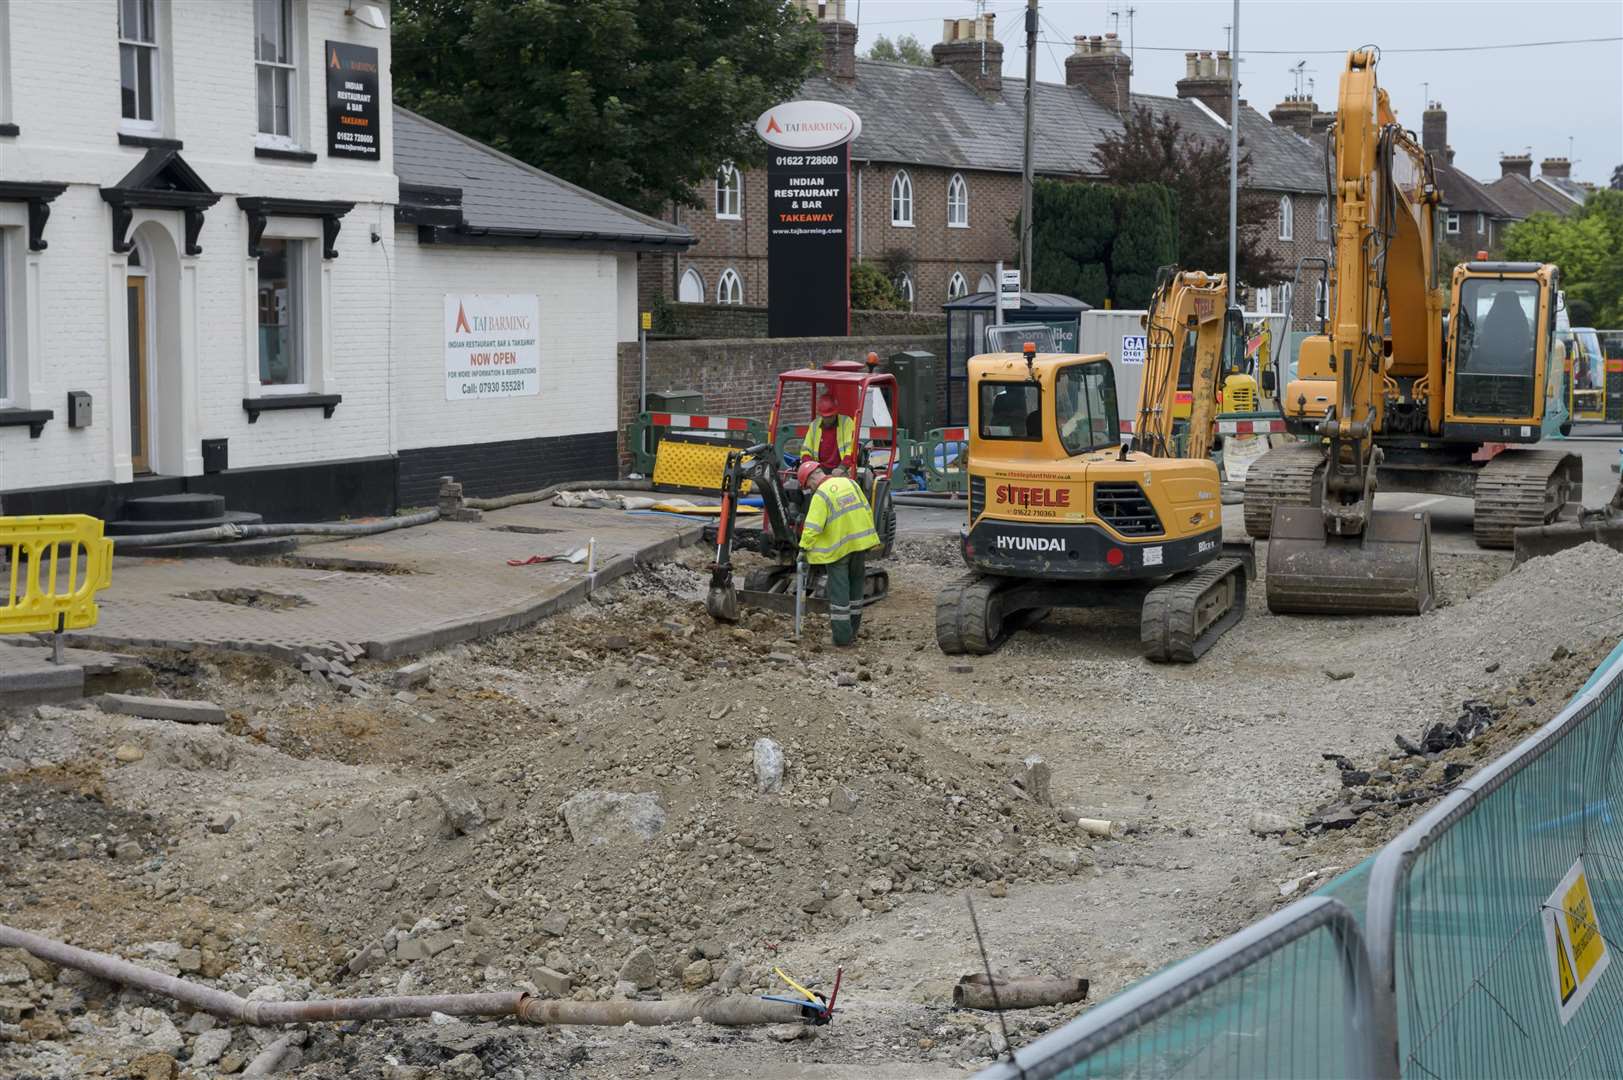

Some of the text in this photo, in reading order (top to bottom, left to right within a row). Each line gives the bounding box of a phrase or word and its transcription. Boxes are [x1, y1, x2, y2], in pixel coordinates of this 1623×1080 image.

[345, 81, 364, 91] INDIAN
[337, 91, 371, 103] RESTAURANT
[346, 103, 363, 112] & BAR
[341, 115, 369, 127] TAKEAWAY
[785, 122, 847, 132] TAJ BARMING
[337, 132, 353, 141] 01622
[776, 155, 839, 166] 01622 728600
[789, 177, 824, 186] INDIAN
[774, 189, 840, 197] RESTAURANT
[791, 200, 822, 209] & BAR
[780, 214, 834, 222] TAKEAWAY
[772, 227, 842, 235] www.tajbarming.com
[473, 315, 530, 331] TAJ BARMING
[497, 340, 506, 348] BAR
[512, 339, 536, 347] TAKEAWAY
[470, 352, 516, 366] NOW OPEN
[471, 369, 500, 377] INFORMATION
[506, 368, 536, 376] RESERVATIONS
[462, 380, 525, 394] Call: 07930 555281
[996, 484, 1071, 508] STEELE
[1013, 508, 1032, 516] 01622
[997, 535, 1066, 552] HYUNDAI
